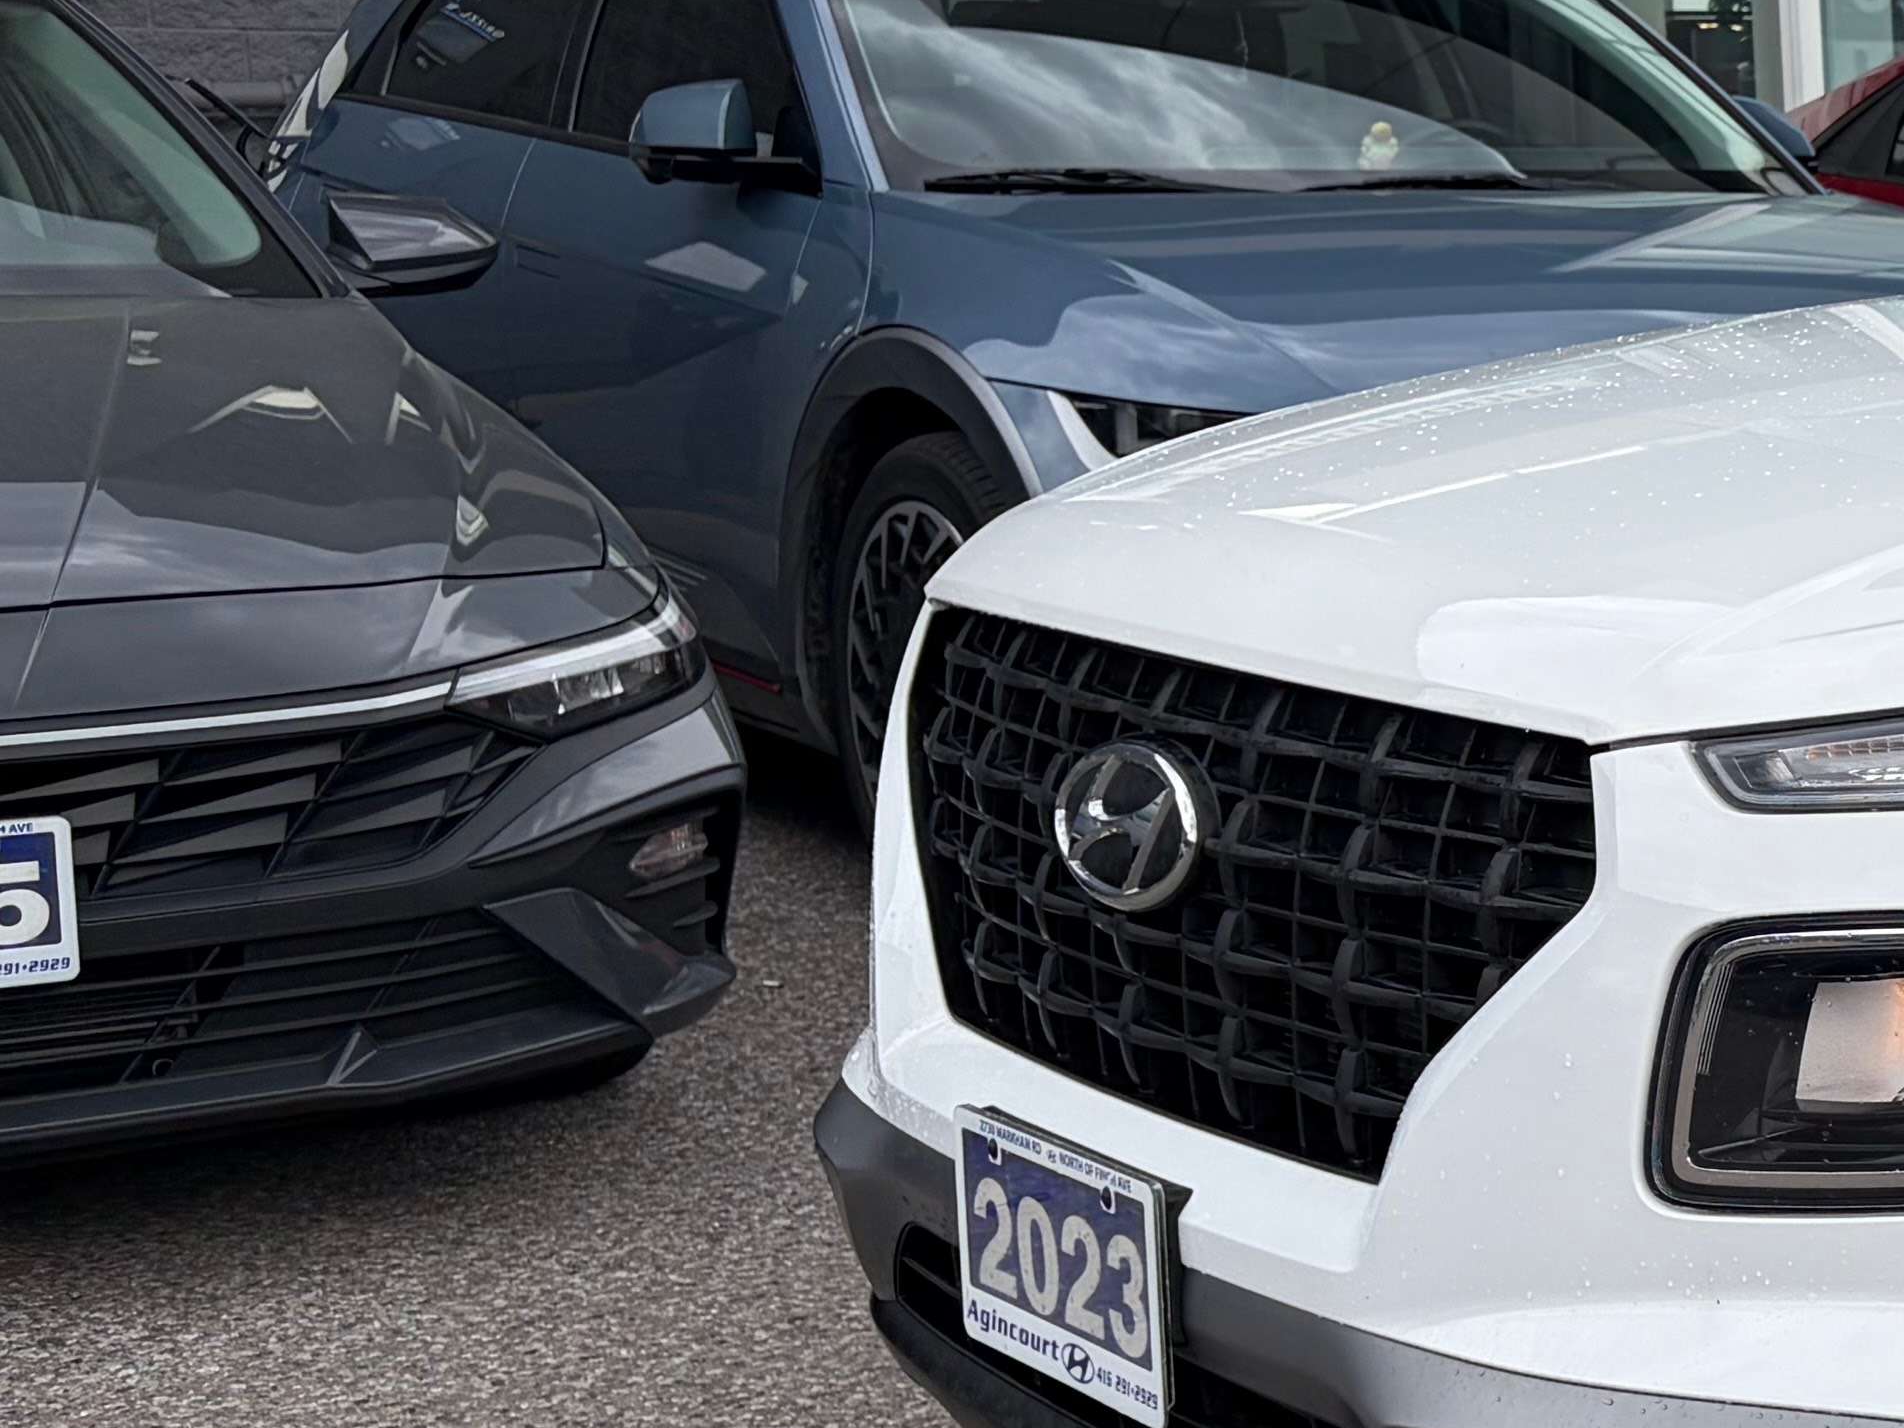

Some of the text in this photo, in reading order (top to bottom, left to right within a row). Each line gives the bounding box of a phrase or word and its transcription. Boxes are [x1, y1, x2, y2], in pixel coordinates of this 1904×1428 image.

[9, 822, 33, 833] AVE
[973, 1177, 1148, 1358] 2023
[967, 1300, 1059, 1360] Agincourt
